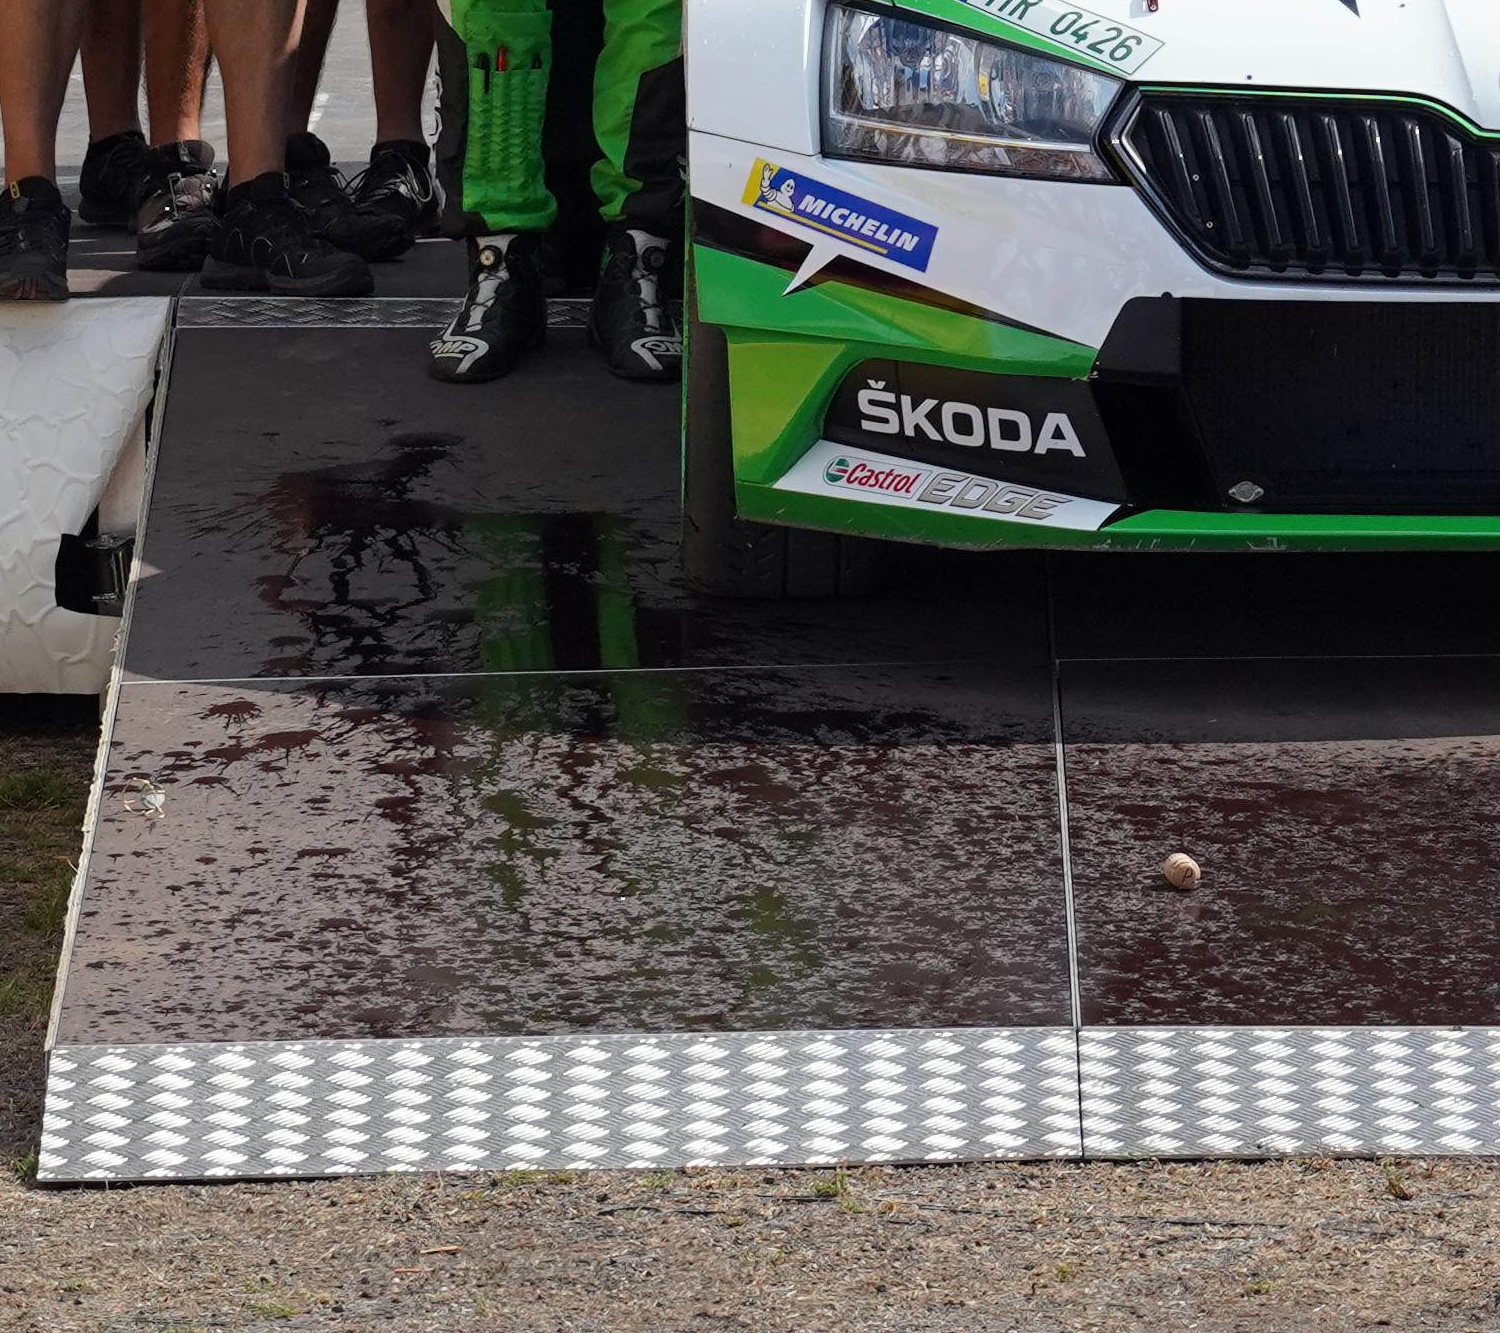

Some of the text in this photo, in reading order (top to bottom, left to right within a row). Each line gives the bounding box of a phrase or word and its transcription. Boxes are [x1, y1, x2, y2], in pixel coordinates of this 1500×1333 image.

[1049, 10, 1143, 63] 0426
[797, 193, 922, 254] MICHELIN
[857, 378, 1087, 459] ŠKODA
[845, 460, 922, 497] Castrol
[916, 471, 1074, 521] EDGE
